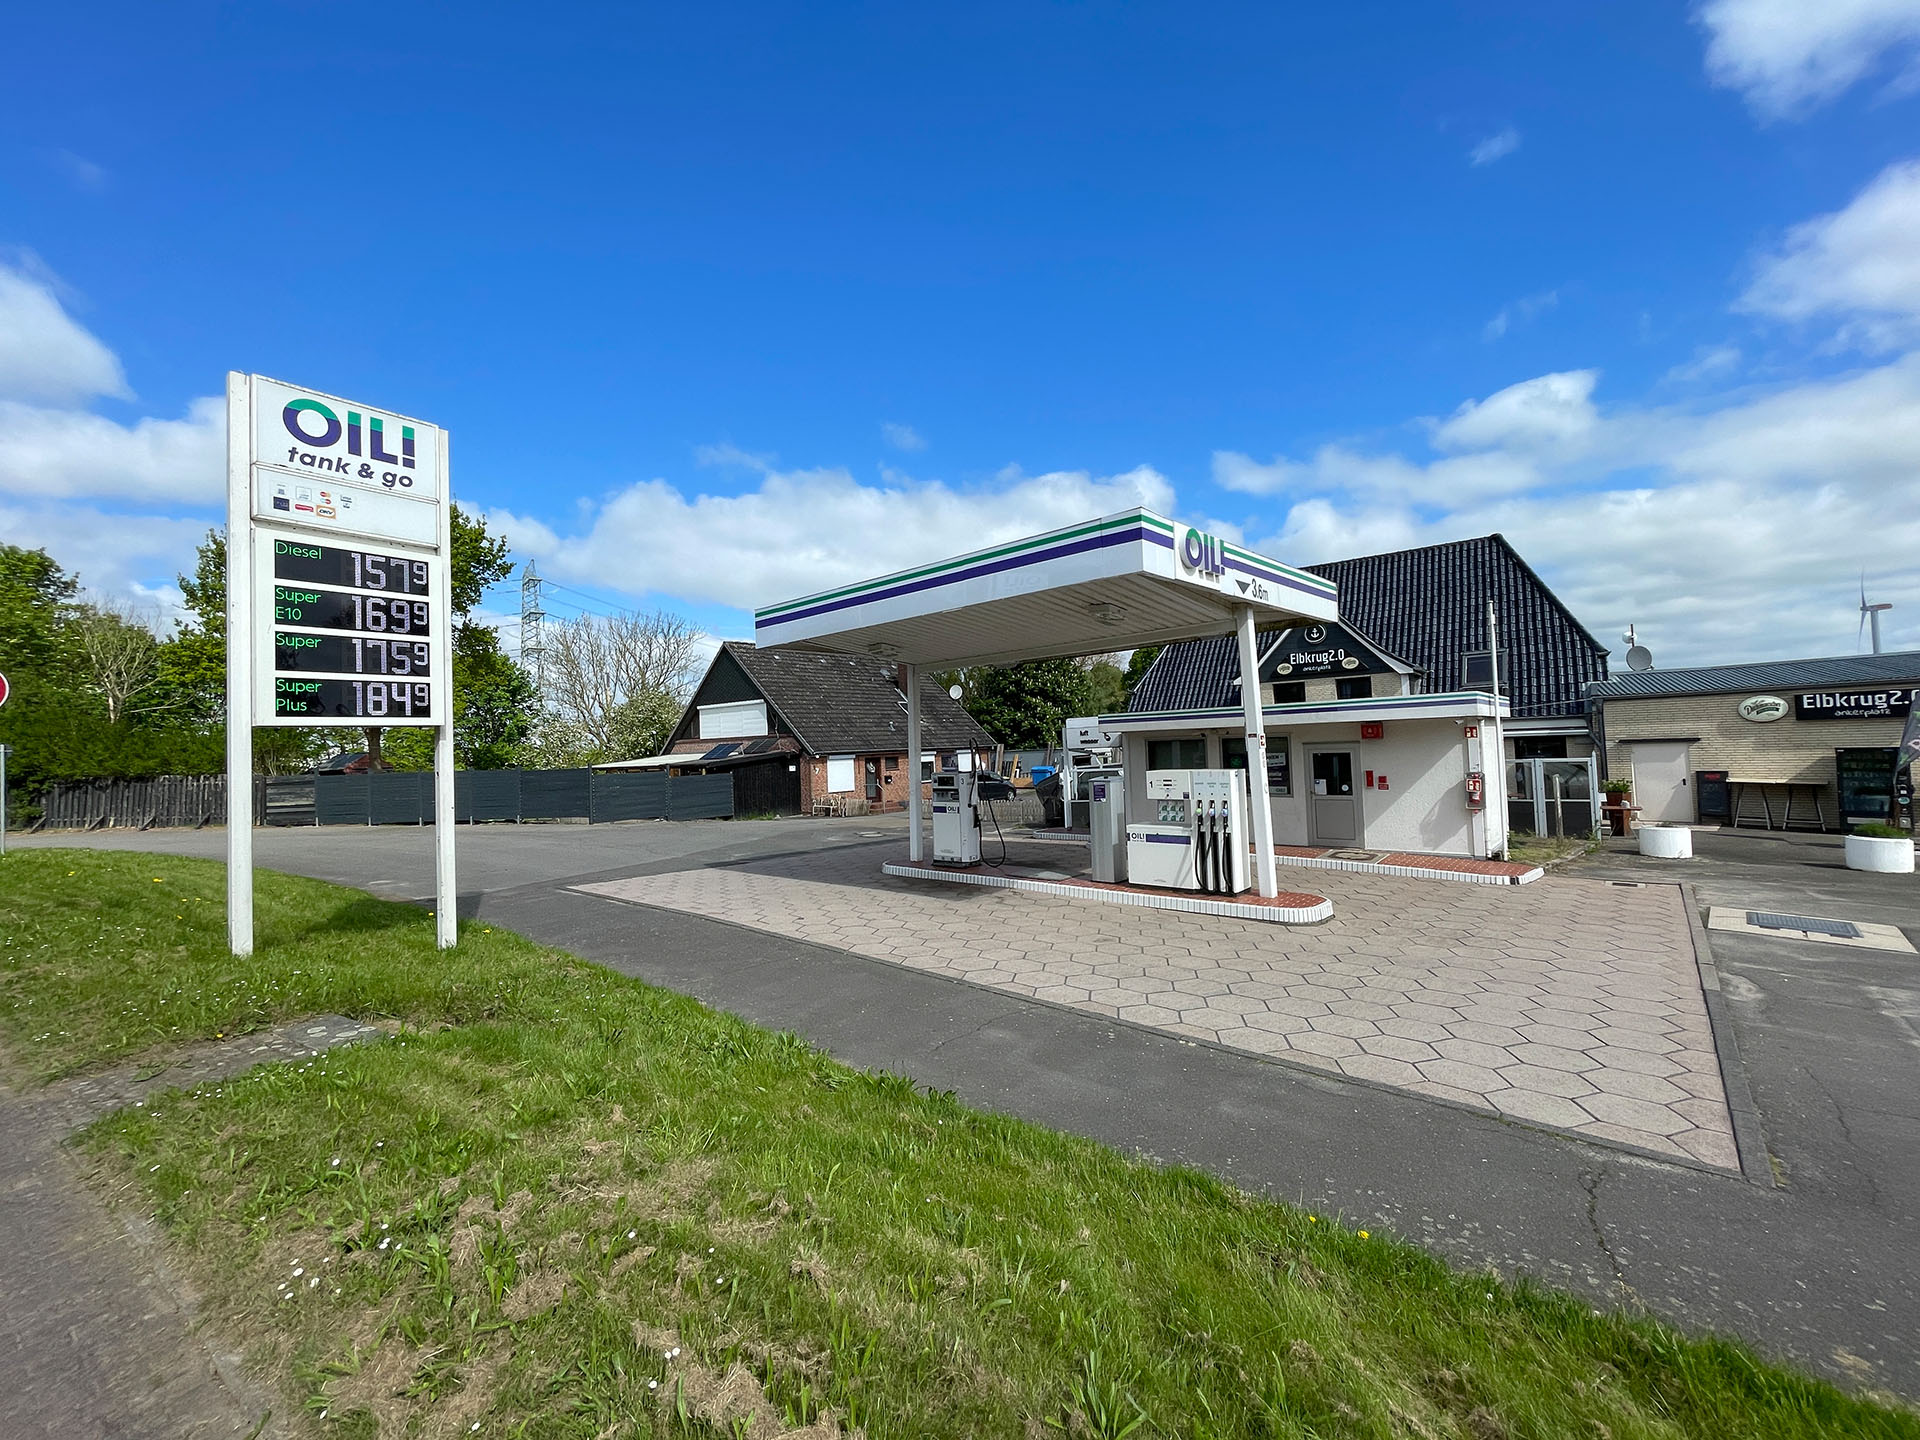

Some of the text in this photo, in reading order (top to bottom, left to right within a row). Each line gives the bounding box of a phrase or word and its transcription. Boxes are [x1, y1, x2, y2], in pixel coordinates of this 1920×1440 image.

[282, 398, 416, 469] OIL!
[288, 446, 413, 488] tank & go
[275, 541, 322, 560] Diesel
[1185, 527, 1226, 576] OIL!
[275, 587, 321, 604] Super
[1251, 578, 1269, 601] 3.6m
[275, 606, 302, 621] E10
[276, 633, 322, 650] Super
[1290, 648, 1345, 665] Elbkrug2.0
[276, 679, 322, 695] Super
[276, 698, 307, 712] Plus
[1834, 708, 1892, 718] ankerplatz
[1149, 780, 1153, 789] 1
[1131, 832, 1145, 840] OIL!
